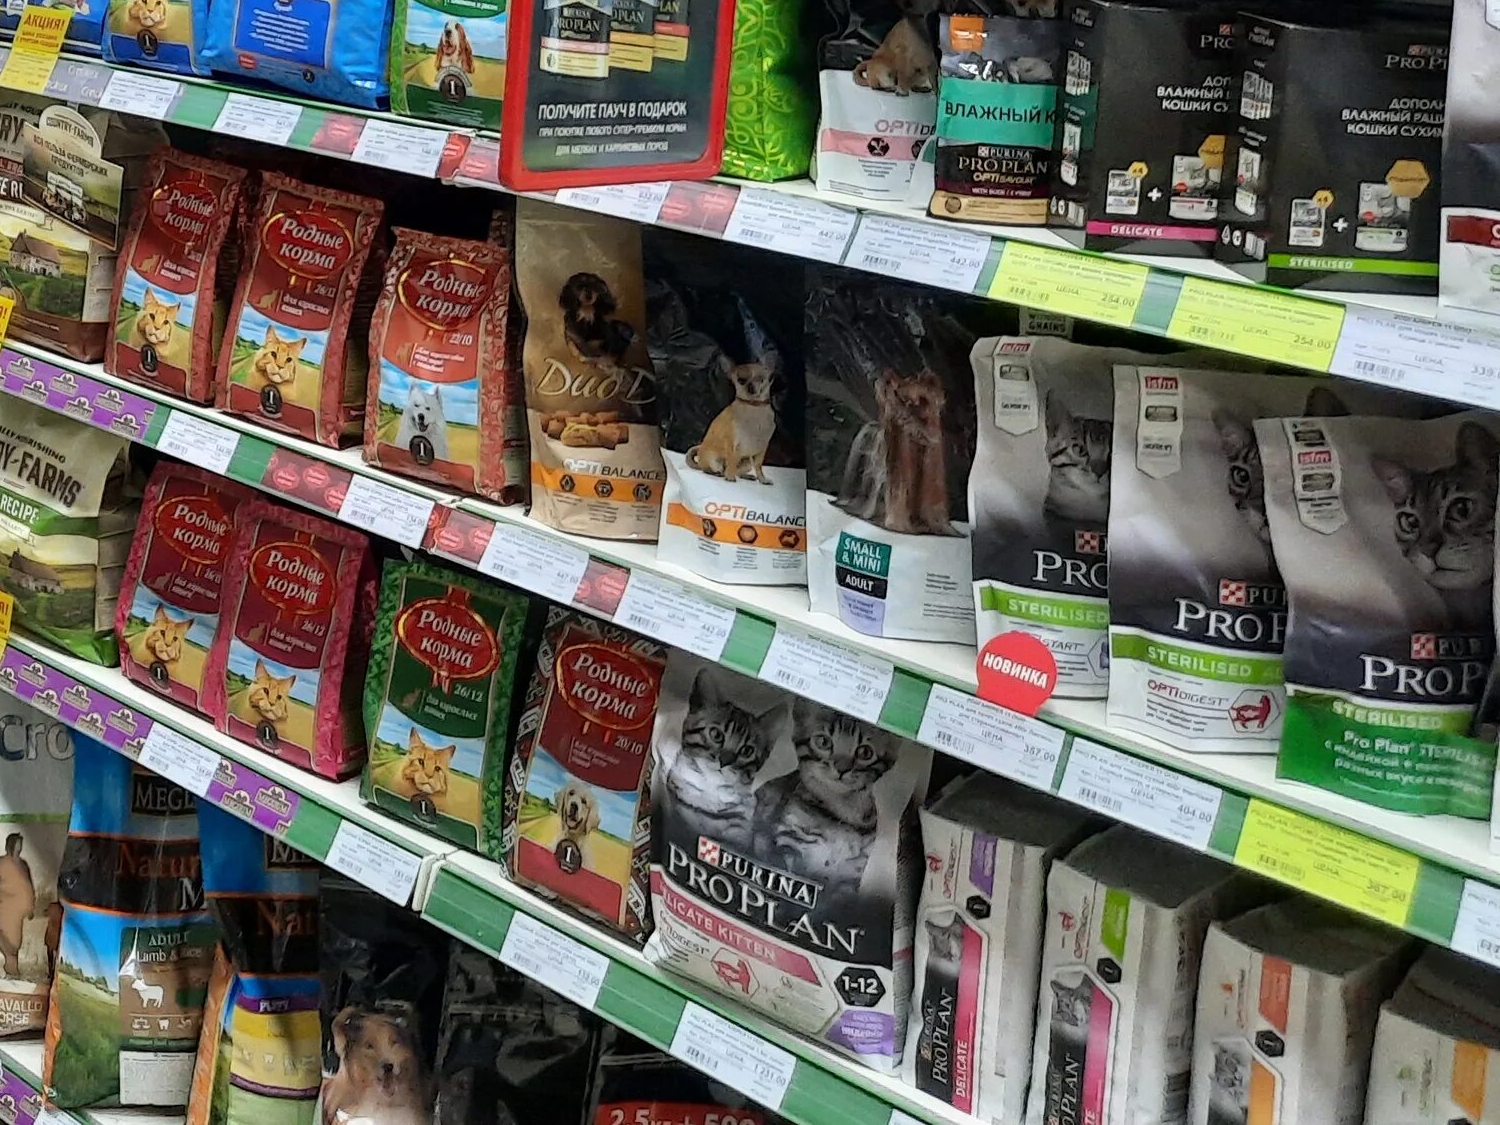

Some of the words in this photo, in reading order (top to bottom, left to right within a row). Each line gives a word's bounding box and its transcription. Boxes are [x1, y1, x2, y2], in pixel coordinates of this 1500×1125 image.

[24, 13, 65, 33] АКЦИЯ!
[1384, 54, 1425, 71] PRO
[1156, 85, 1224, 101] ВЛАЖНЫЙ
[1161, 97, 1210, 112] КОШКИ
[538, 102, 598, 121] ПОЛУЧИТЕ
[598, 102, 628, 119] ПАУЧ
[628, 102, 637, 118] В
[636, 100, 688, 120] ПОДАРОК
[943, 99, 1043, 126] ВЛАЖНЫЙ
[1341, 108, 1412, 124] ВЛАЖНЫЙ
[538, 127, 553, 138] ПРИ
[555, 144, 571, 157] ДЛЯ
[990, 146, 1032, 160] PURINA
[957, 156, 1000, 172] PRO
[1001, 158, 1049, 175] PLAN
[169, 189, 216, 219] Родные
[164, 212, 205, 237] корма
[280, 217, 345, 252] Родные
[1110, 225, 1163, 237] DELICATE
[279, 241, 337, 271] корма
[1288, 258, 1354, 271] STERILISED
[419, 268, 486, 302] Родные
[1145, 377, 1179, 392] isfm
[0, 493, 40, 523] RECIPE
[172, 503, 228, 538] Родные
[172, 526, 222, 554] корма
[842, 537, 883, 560] SMALL
[265, 548, 327, 587] Родные
[840, 551, 852, 565] &
[851, 552, 883, 574] MINI
[264, 574, 320, 606] корма
[844, 573, 874, 594] ADULT
[1007, 597, 1109, 624] STERILISED
[1171, 595, 1264, 643] PRO
[416, 607, 485, 647] Родные
[419, 637, 474, 669] корма
[1146, 645, 1252, 678] STERILISED
[570, 653, 649, 699] Родные
[981, 651, 1049, 690] НОВИНКА
[1359, 656, 1457, 698] PRO
[453, 682, 485, 704] 26/12
[570, 679, 639, 721] корма
[1146, 678, 1229, 708] OPTIDIGEST
[1332, 698, 1445, 731] STERILISED
[614, 734, 644, 757] 20/10
[1343, 729, 1372, 750] Pro
[1373, 738, 1410, 755] Plan
[722, 852, 814, 908] PURINA
[666, 843, 736, 906] PRO
[741, 882, 867, 958] PLAN
[147, 930, 189, 948] ADULT
[842, 974, 878, 996] 1-12
[953, 1038, 969, 1098] DELICATE
